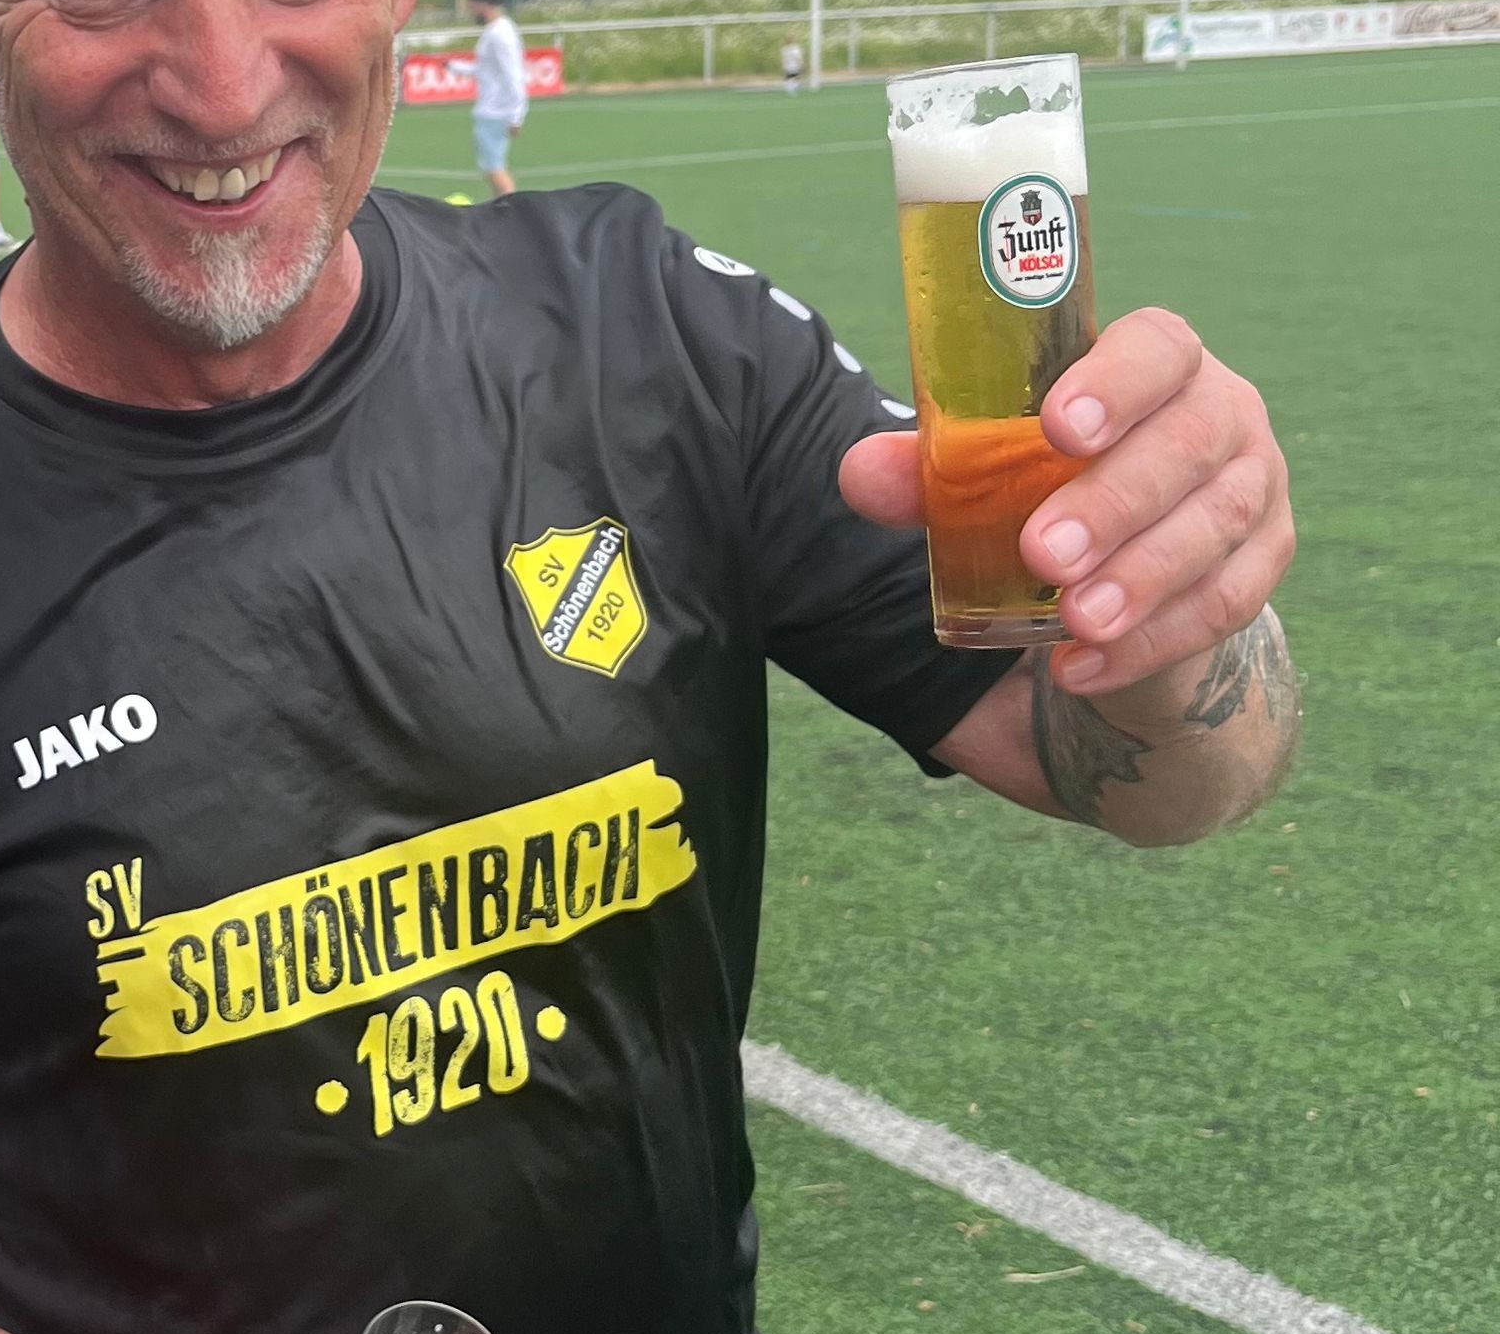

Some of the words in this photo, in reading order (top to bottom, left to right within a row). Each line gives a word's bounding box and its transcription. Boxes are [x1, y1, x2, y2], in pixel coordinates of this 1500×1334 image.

[997, 217, 1066, 263] Zunft
[1018, 253, 1064, 273] KÖLSCH
[538, 554, 565, 588] SV
[543, 526, 624, 652] Schönenbach
[587, 591, 625, 642] 1920
[13, 694, 158, 790] JAKO
[85, 857, 143, 939] SV
[167, 806, 640, 1034] SCHÖNENBACH
[357, 970, 530, 1138] 1920
